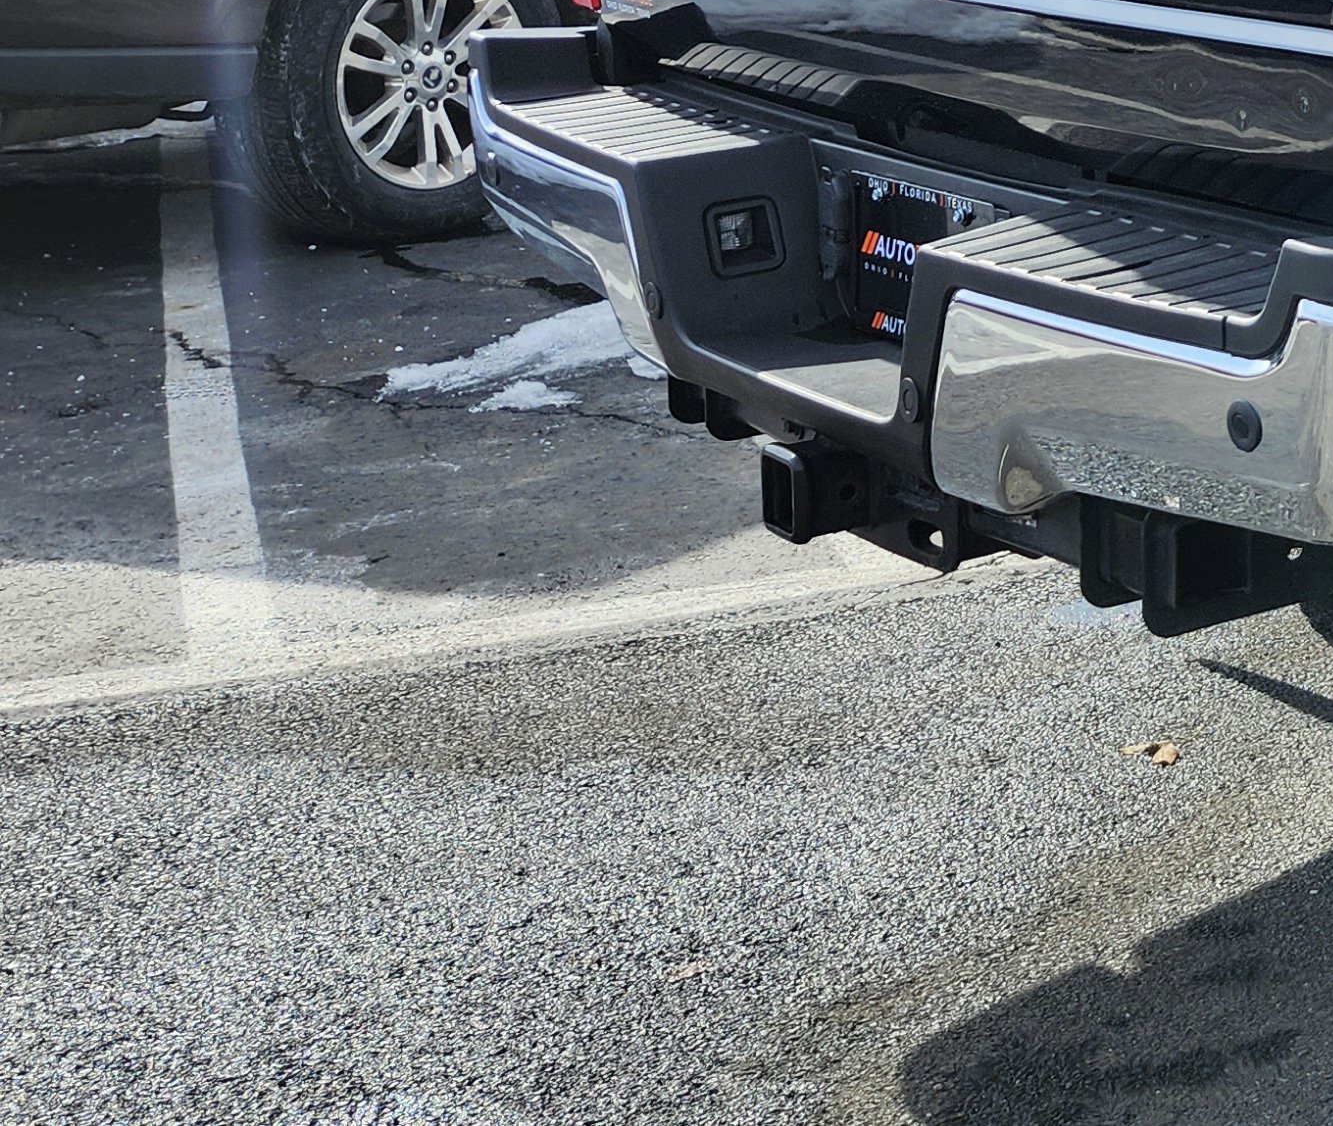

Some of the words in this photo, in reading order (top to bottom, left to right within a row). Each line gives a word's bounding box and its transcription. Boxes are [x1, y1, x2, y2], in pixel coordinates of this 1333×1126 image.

[868, 177, 889, 191] OHIO
[899, 184, 937, 204] FLORIDA
[947, 196, 973, 214] TEXAS
[874, 234, 920, 266] AUTO
